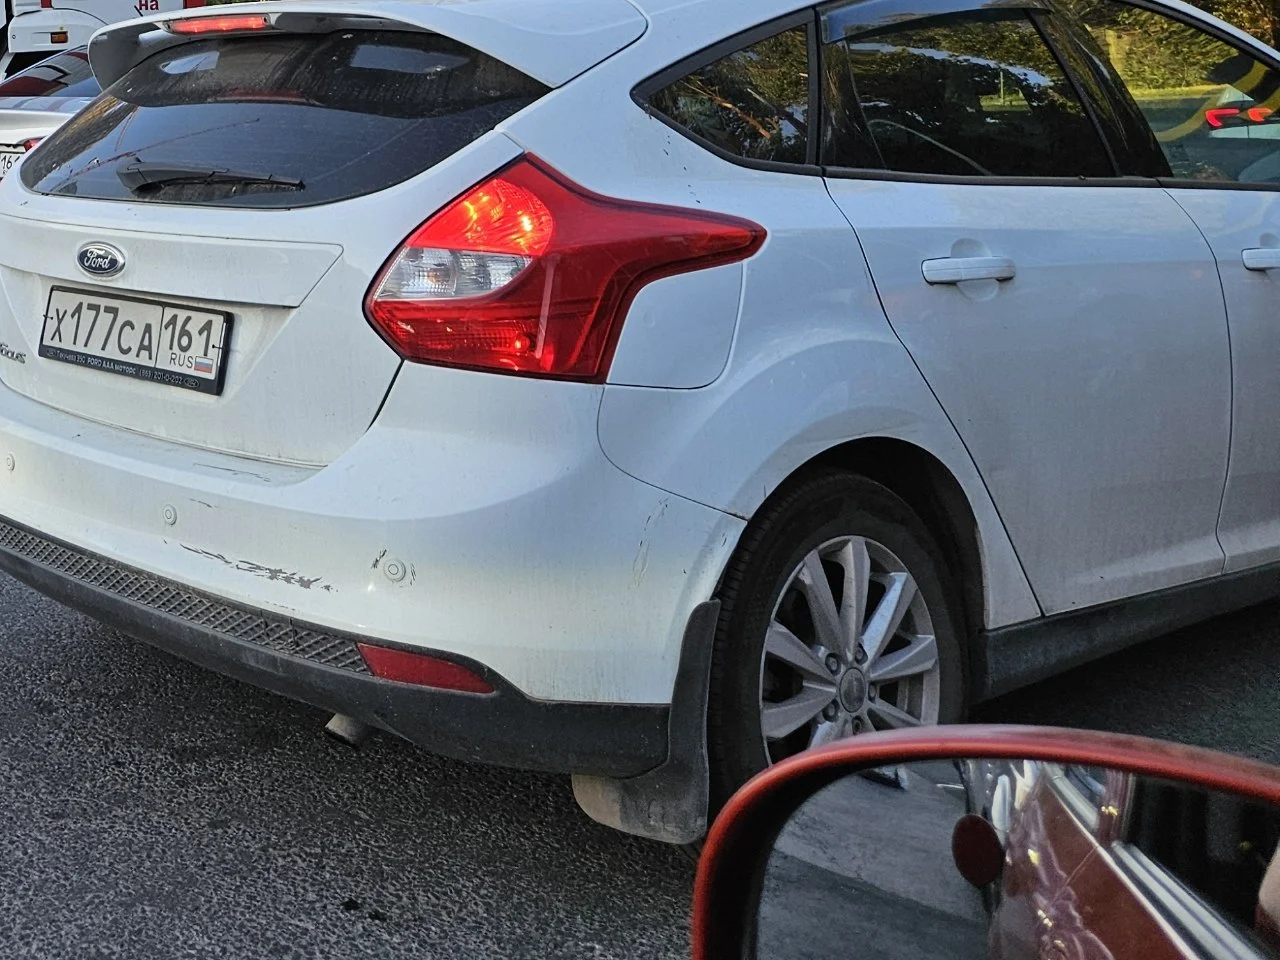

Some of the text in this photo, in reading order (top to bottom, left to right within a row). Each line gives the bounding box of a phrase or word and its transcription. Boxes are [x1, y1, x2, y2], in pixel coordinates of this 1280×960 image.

[84, 248, 112, 269] Ford
[164, 313, 214, 357] 161
[87, 356, 102, 368] FORD
[170, 352, 194, 369] RUS
